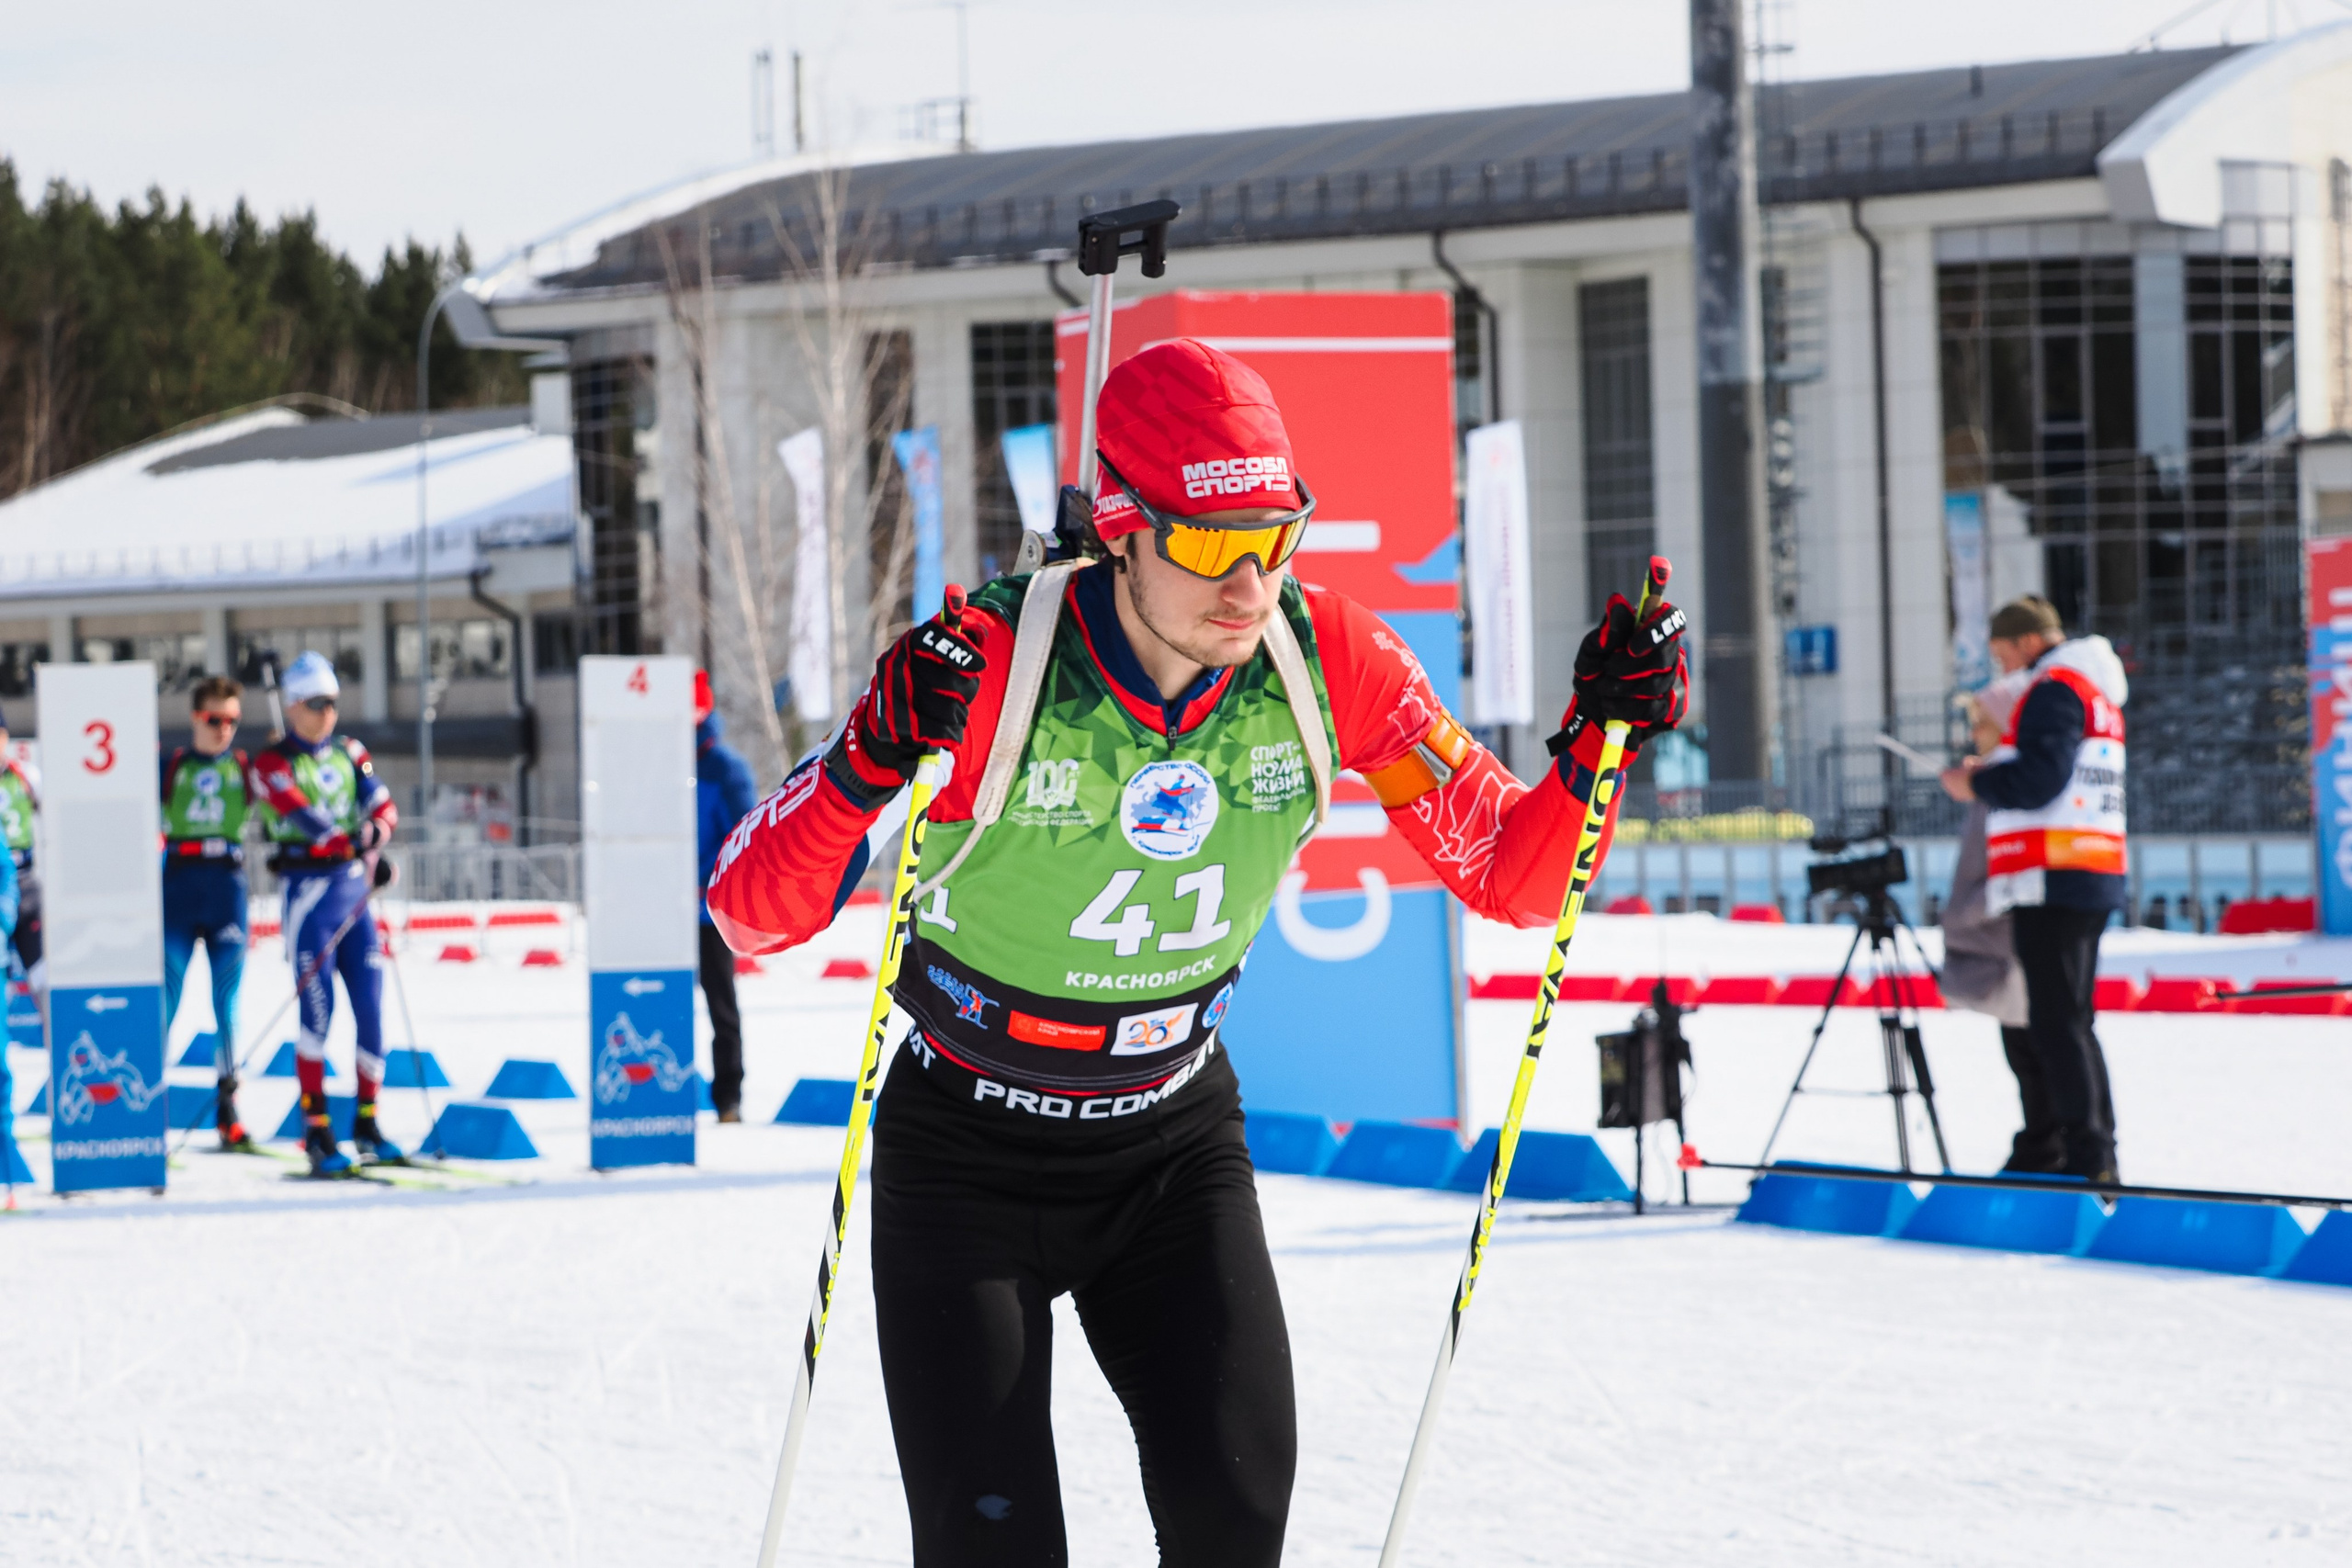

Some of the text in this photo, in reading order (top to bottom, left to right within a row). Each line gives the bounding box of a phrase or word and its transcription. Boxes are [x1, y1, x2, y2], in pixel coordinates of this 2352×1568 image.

[1651, 608, 1688, 645] LEKI
[922, 630, 974, 667] LEKI
[627, 663, 650, 695] 4
[82, 719, 117, 774] 3
[1251, 770, 1306, 795] ЖИЗНИ
[1068, 863, 1232, 957] 41
[1065, 954, 1217, 990] КРАСНОЯРСК
[974, 1032, 1217, 1119] PRO COMBAT
